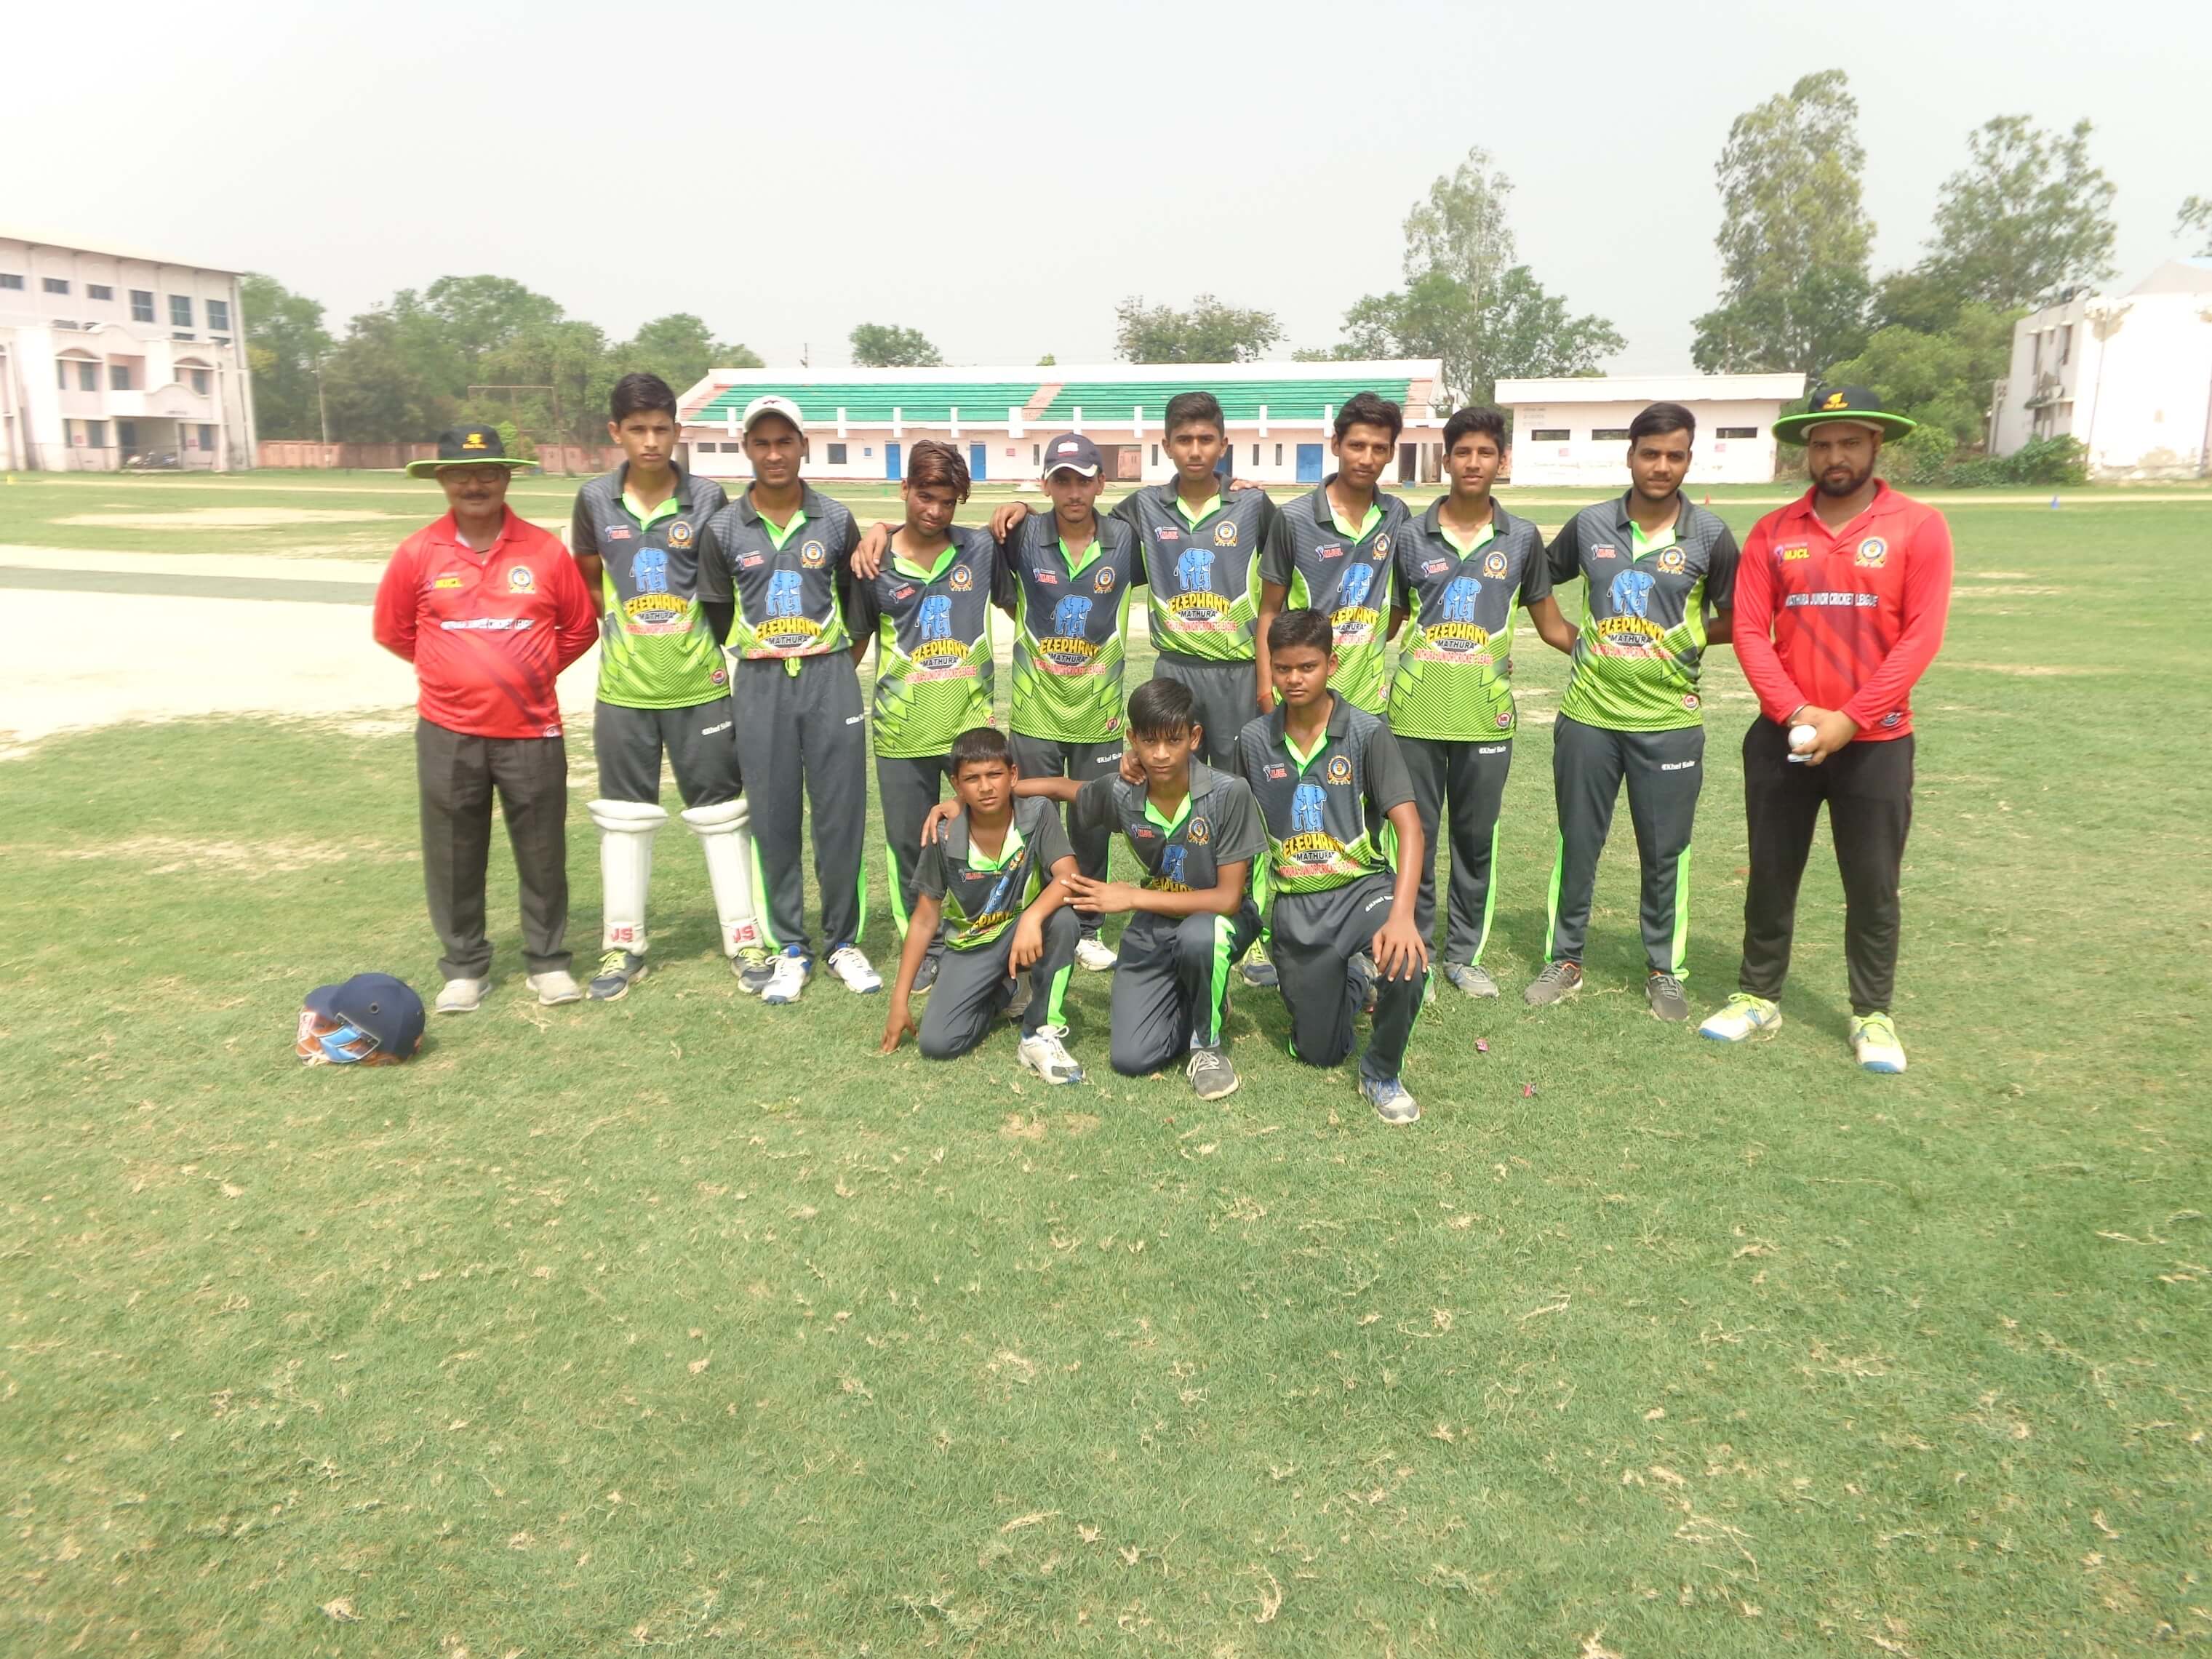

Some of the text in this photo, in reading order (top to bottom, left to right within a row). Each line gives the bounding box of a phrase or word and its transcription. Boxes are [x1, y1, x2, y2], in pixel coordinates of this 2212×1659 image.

[625, 593, 688, 616] ELEPHANT
[1167, 592, 1231, 617] ELEPHANT
[1181, 610, 1216, 618] MATHURA
[756, 617, 823, 641] ELEPHANT
[1426, 622, 1490, 648] ELEPHANT
[1598, 617, 1666, 642] ELEPHANT
[768, 636, 807, 644] MATHURA
[1039, 637, 1100, 658] ELEPHANT
[1437, 640, 1474, 649] MATHURA
[1610, 634, 1653, 643] MATHURA
[911, 639, 970, 664] ELEPHANT
[1050, 653, 1086, 663] MATHURA
[923, 657, 957, 667] MATHURA
[1283, 833, 1346, 860] ELEPHANT
[1296, 852, 1333, 860] MATHURA
[611, 927, 633, 942] JS
[733, 925, 755, 943] JS
